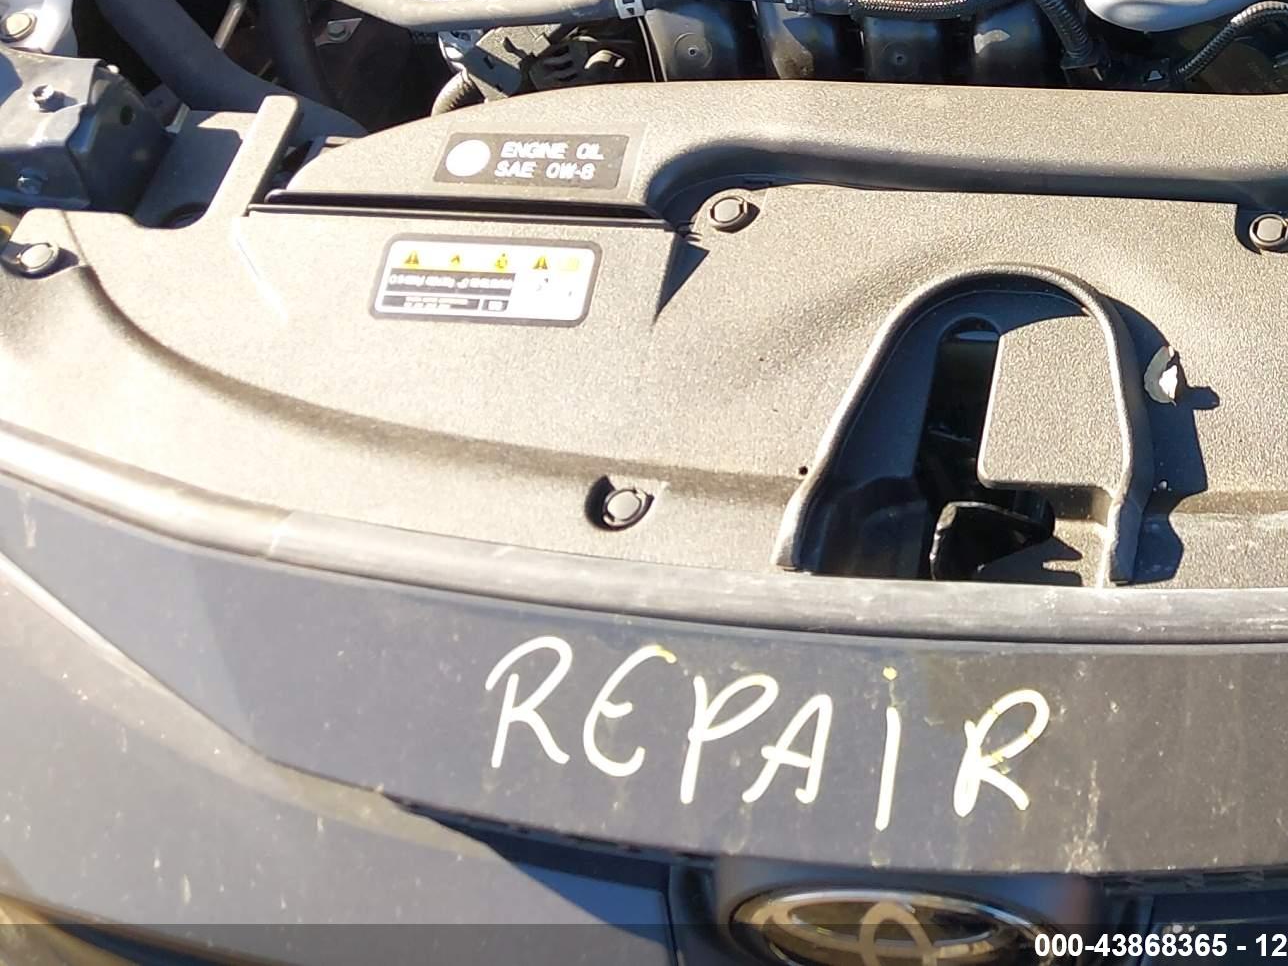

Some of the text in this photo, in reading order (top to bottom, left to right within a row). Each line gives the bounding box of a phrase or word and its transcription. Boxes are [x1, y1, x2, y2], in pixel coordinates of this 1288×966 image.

[500, 140, 605, 161] ENGINE OIL
[494, 160, 537, 178] SAE
